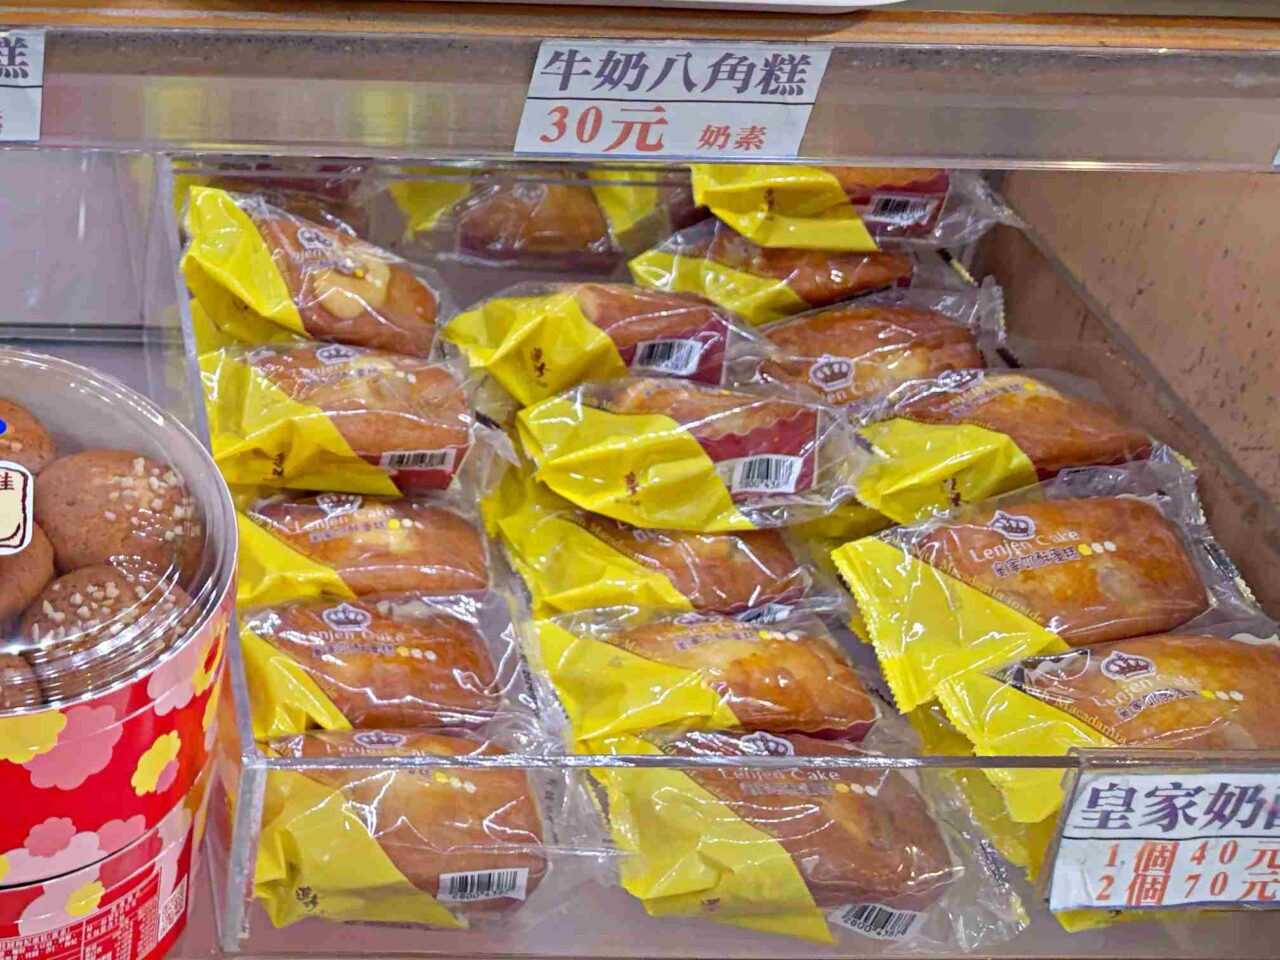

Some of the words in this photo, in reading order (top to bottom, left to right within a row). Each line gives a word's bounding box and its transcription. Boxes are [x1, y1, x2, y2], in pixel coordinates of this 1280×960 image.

[540, 49, 811, 96] 牛奶八角糕
[540, 105, 668, 152] 30元
[697, 125, 767, 151] 奶素
[969, 540, 1033, 563] Lenjen
[1036, 530, 1080, 546] Cake
[1053, 694, 1128, 746] Macadamia
[1073, 782, 1280, 833] 皇家奶
